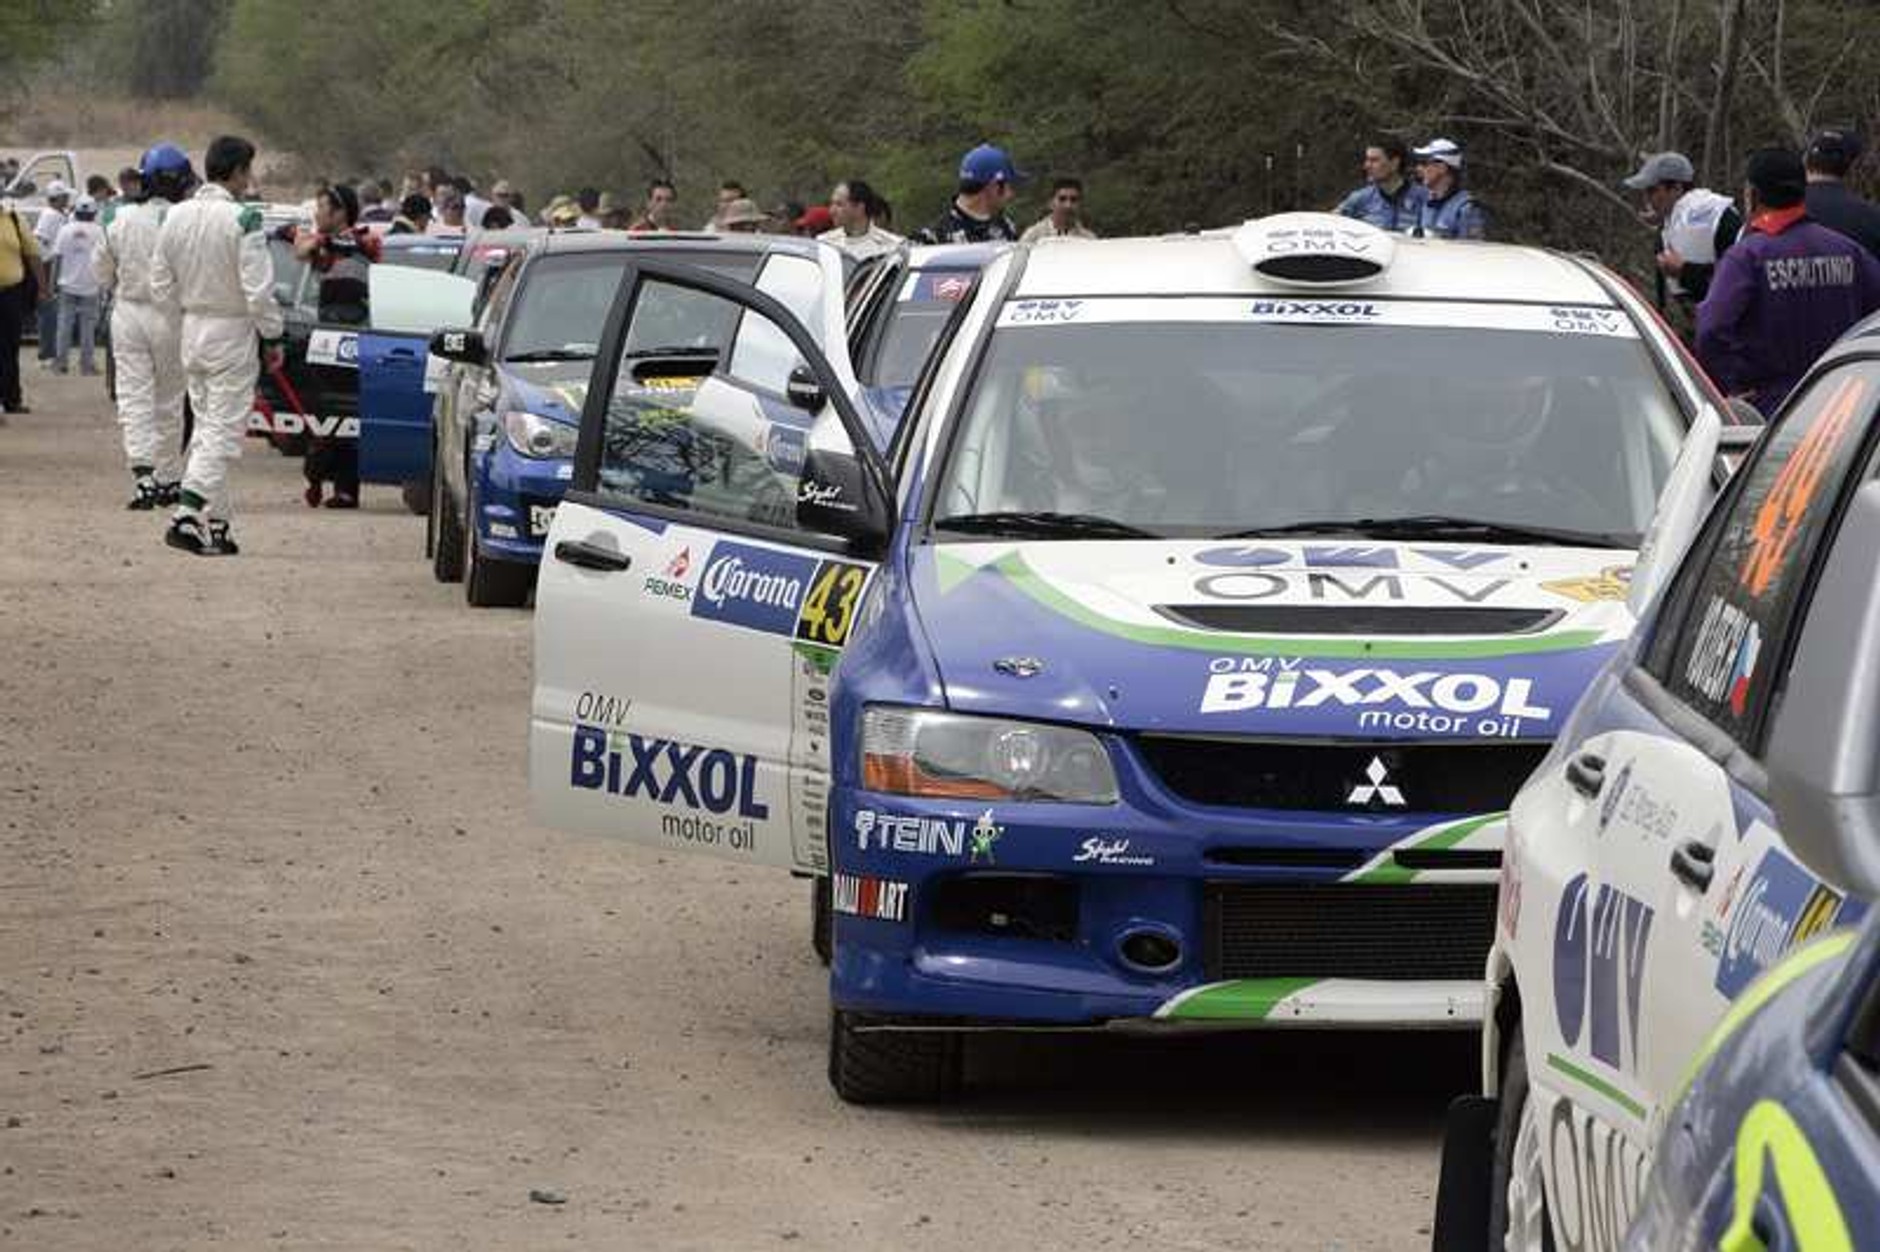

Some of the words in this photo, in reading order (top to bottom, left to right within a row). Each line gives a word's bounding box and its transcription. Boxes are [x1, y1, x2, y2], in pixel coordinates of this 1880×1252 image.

[703, 555, 800, 609] Corona
[1194, 572, 1512, 601] OMV
[803, 564, 863, 643] 43
[1210, 658, 1301, 673] OMV
[576, 692, 631, 725] OMV
[1360, 712, 1469, 734] motor
[1478, 716, 1519, 738] oil
[662, 814, 723, 843] motor
[729, 823, 754, 850] oil
